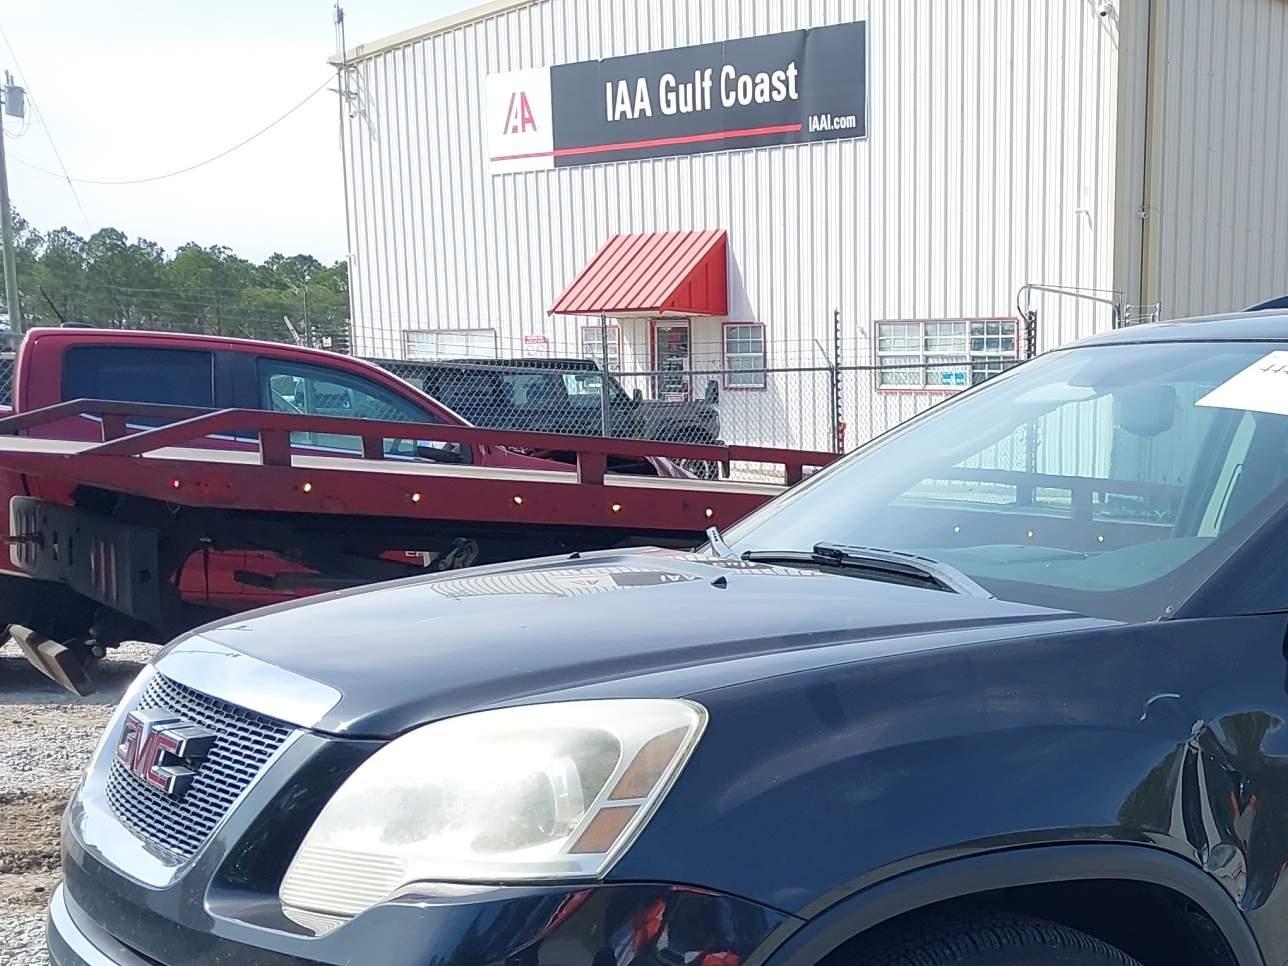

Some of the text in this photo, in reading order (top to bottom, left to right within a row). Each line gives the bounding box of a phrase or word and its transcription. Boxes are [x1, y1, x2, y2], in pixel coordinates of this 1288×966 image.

[606, 61, 799, 121] IAA Gulf Coast
[117, 710, 194, 794] GMC
